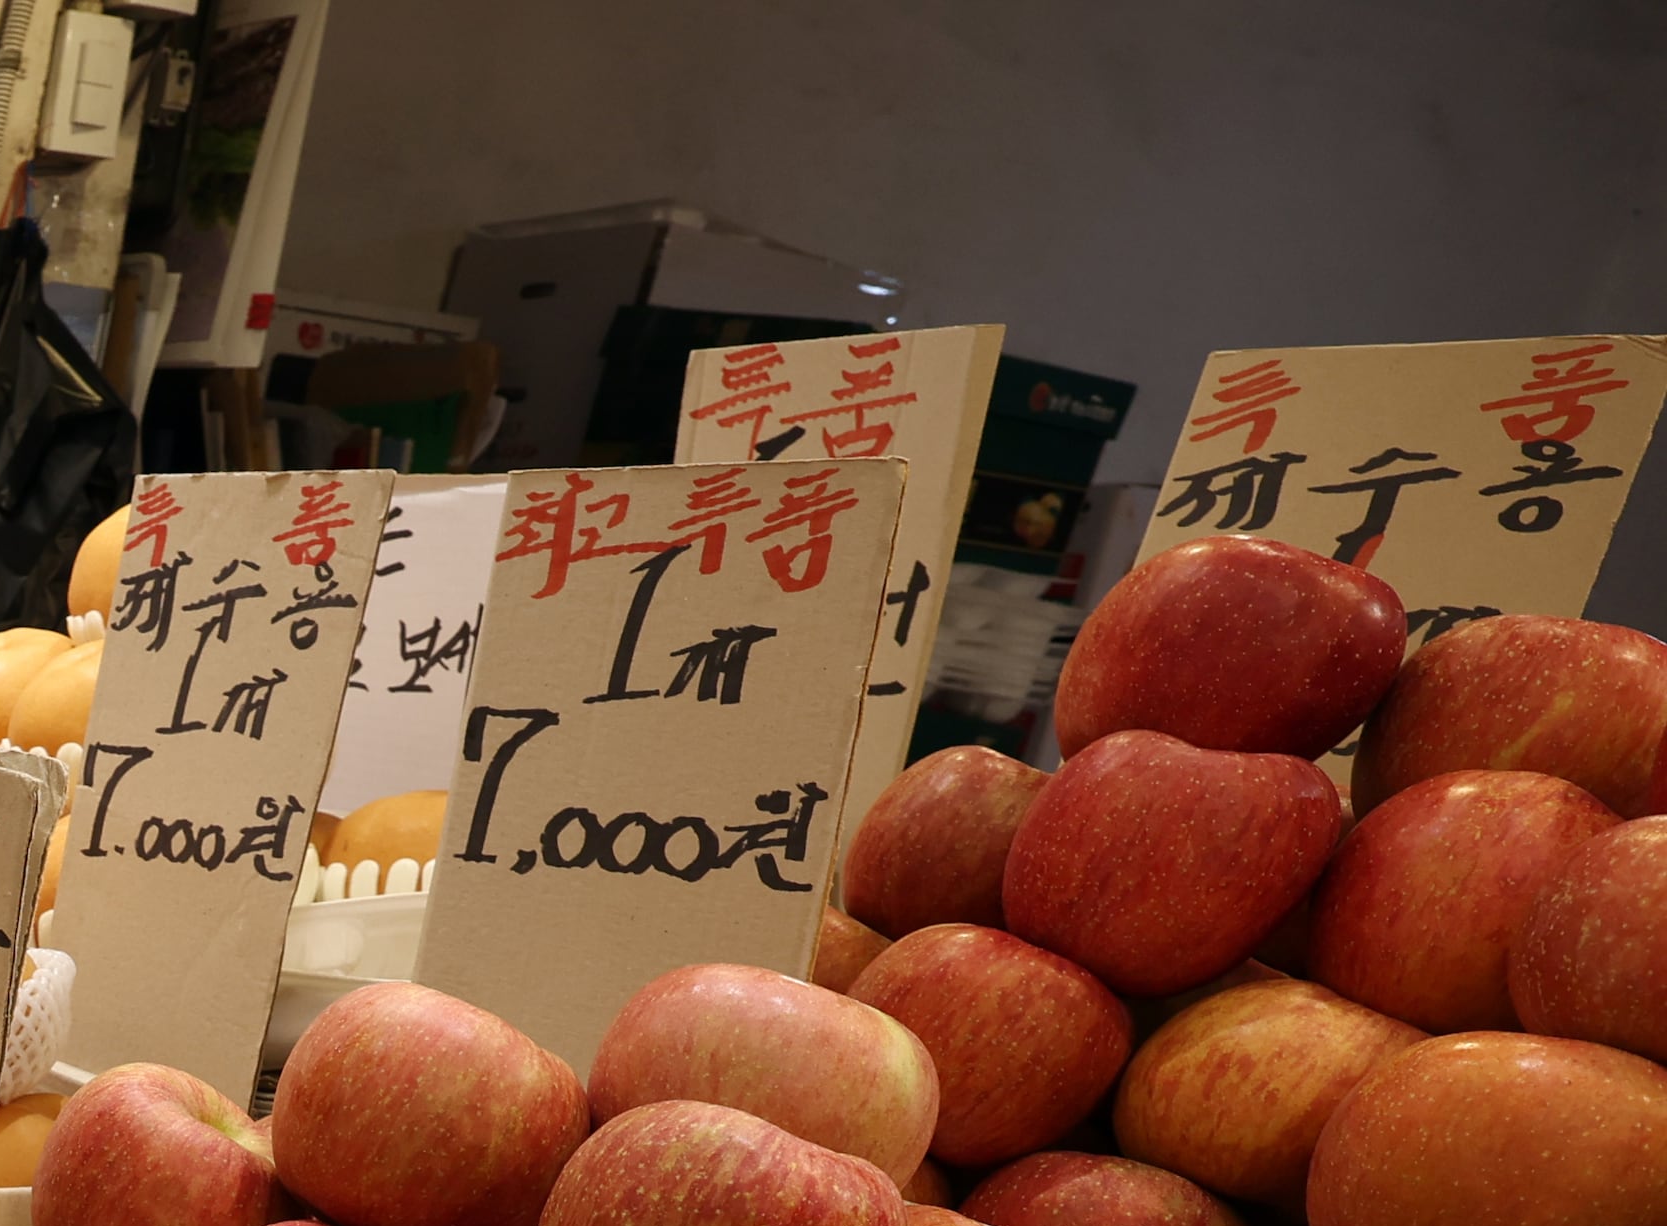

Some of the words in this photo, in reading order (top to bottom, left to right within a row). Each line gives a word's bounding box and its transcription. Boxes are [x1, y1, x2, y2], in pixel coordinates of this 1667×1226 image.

[113, 553, 357, 651] 제수용
[80, 741, 303, 879] 7.000원
[454, 705, 828, 891] 7,000원
